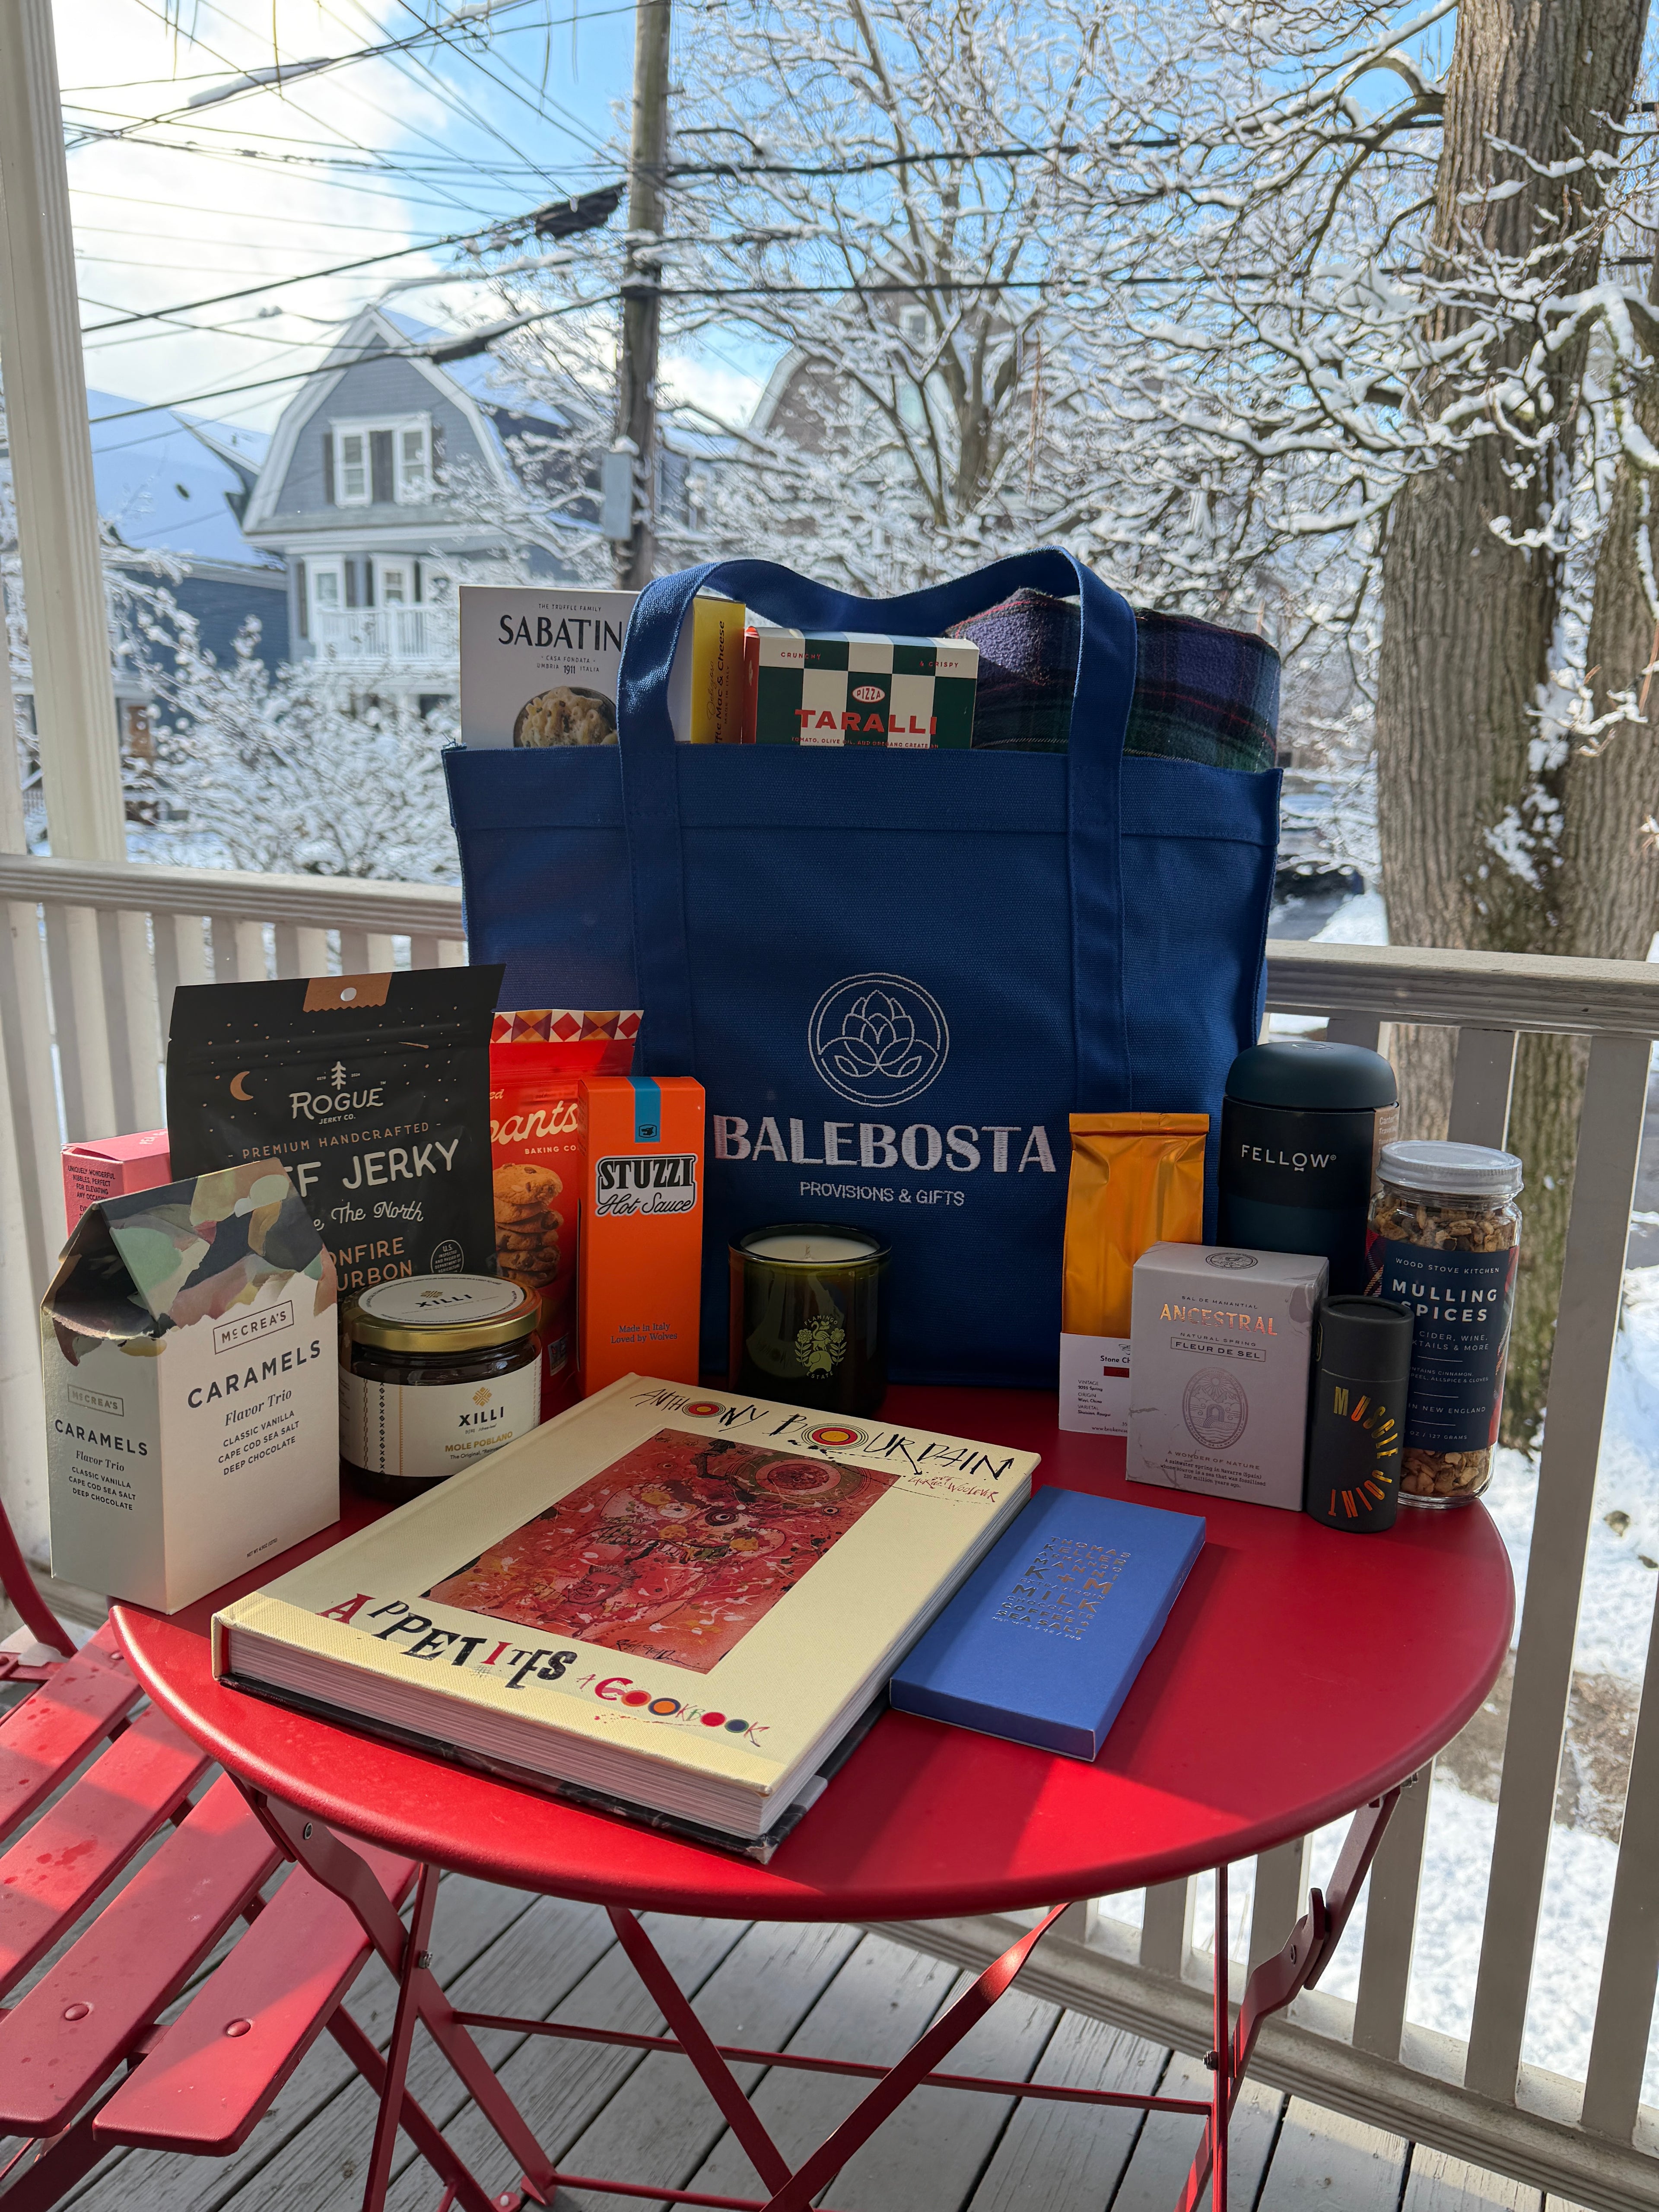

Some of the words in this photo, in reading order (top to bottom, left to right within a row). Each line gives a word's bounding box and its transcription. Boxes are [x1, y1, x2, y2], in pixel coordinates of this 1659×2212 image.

[499, 615, 622, 652] SABATIN
[781, 652, 821, 660] CRUNCHY
[563, 665, 575, 674] 1911
[717, 676, 723, 685] &
[857, 687, 880, 700] PIZZA
[795, 709, 937, 734] TARALLI
[289, 1088, 383, 1120] ROGUE
[319, 1116, 341, 1125] JERKY
[242, 1141, 311, 1159] PREMIUM
[319, 1122, 429, 1147] HANDCRAFTED
[525, 1146, 559, 1154] BAKING
[713, 1115, 1056, 1172] BALEBOSTA
[68, 1166, 87, 1174] UNIQUELY
[89, 1169, 115, 1179] WONDERFUL
[343, 1139, 458, 1189] JERKY
[601, 1158, 693, 1189] STUZZI
[86, 1185, 108, 1195] ELEVATING
[800, 1181, 894, 1202] PROVISIONS
[899, 1189, 912, 1203] &
[916, 1190, 965, 1206] GIFTS
[331, 1202, 366, 1224] The
[374, 1201, 423, 1222] North
[597, 1194, 641, 1215] Hot
[642, 1192, 691, 1213] Sauce
[1395, 1258, 1423, 1268] WOOD
[1428, 1265, 1459, 1273] STOVE
[415, 1294, 472, 1307] XILLI
[1392, 1279, 1497, 1303] MULLING
[1212, 1300, 1257, 1309] MANANTIAL
[653, 1322, 671, 1331] Italy
[804, 1315, 838, 1325] FLAMINGO
[1160, 1304, 1278, 1335] ANCESTRAL
[611, 1335, 635, 1343] Loved
[638, 1335, 646, 1343] by
[1176, 1342, 1213, 1352] FLEUR
[1180, 1332, 1220, 1341] NATURAL
[1419, 1331, 1455, 1341] CIDER,
[188, 1340, 320, 1408] CARAMELS
[806, 1370, 833, 1379] ESTATE
[225, 1402, 264, 1426] Flavor
[268, 1389, 292, 1408] Trio
[459, 1406, 503, 1427] XILLI
[223, 1427, 258, 1447] CLASSIC
[261, 1410, 294, 1430] VANILLA
[1333, 1386, 1398, 1459] MUSCLE
[55, 1419, 147, 1456] CARAMELS
[219, 1448, 241, 1463] CAPE
[244, 1440, 261, 1452] COD
[264, 1431, 278, 1443] SEA
[281, 1421, 299, 1434] SALT
[445, 1443, 472, 1452] MOLE
[474, 1431, 512, 1448] POBLANO
[630, 1389, 769, 1432] ANTHONY
[769, 1413, 1015, 1481] BOURDAIN
[76, 1450, 102, 1465] Flavor
[105, 1459, 124, 1471] Trio
[224, 1460, 245, 1475] DEEP
[248, 1436, 296, 1464] CHOCOLATE
[1175, 1452, 1210, 1461] WONDER
[1227, 1461, 1260, 1470] NATURE
[69, 1476, 85, 1486] CAPE
[87, 1482, 101, 1491] COD
[103, 1487, 117, 1496] SEA
[119, 1491, 136, 1500] SALT
[72, 1467, 99, 1480] CLASSIC
[101, 1475, 131, 1488] VANILLA
[73, 1488, 89, 1497] DEEP
[92, 1494, 133, 1510] CHOCOLATE
[1328, 1470, 1392, 1518] JOINT
[1043, 1543, 1126, 1566] KELLER
[1051, 1536, 1131, 1558] THOMAS
[1034, 1557, 1119, 1581] MANNI
[1038, 1551, 1122, 1572] ARMANDO
[1024, 1565, 1050, 1580] K
[1058, 1574, 1075, 1583] +
[1083, 1578, 1113, 1594] M
[1007, 1596, 1094, 1620] CHOCOLATE
[1012, 1584, 1101, 1613] MILK
[995, 1610, 1031, 1622] SEA
[1037, 1619, 1086, 1635] SALT
[1002, 1602, 1075, 1623] COFFEE
[315, 1592, 577, 1691] APPETITES
[594, 1677, 770, 1748] COOKBOOK
